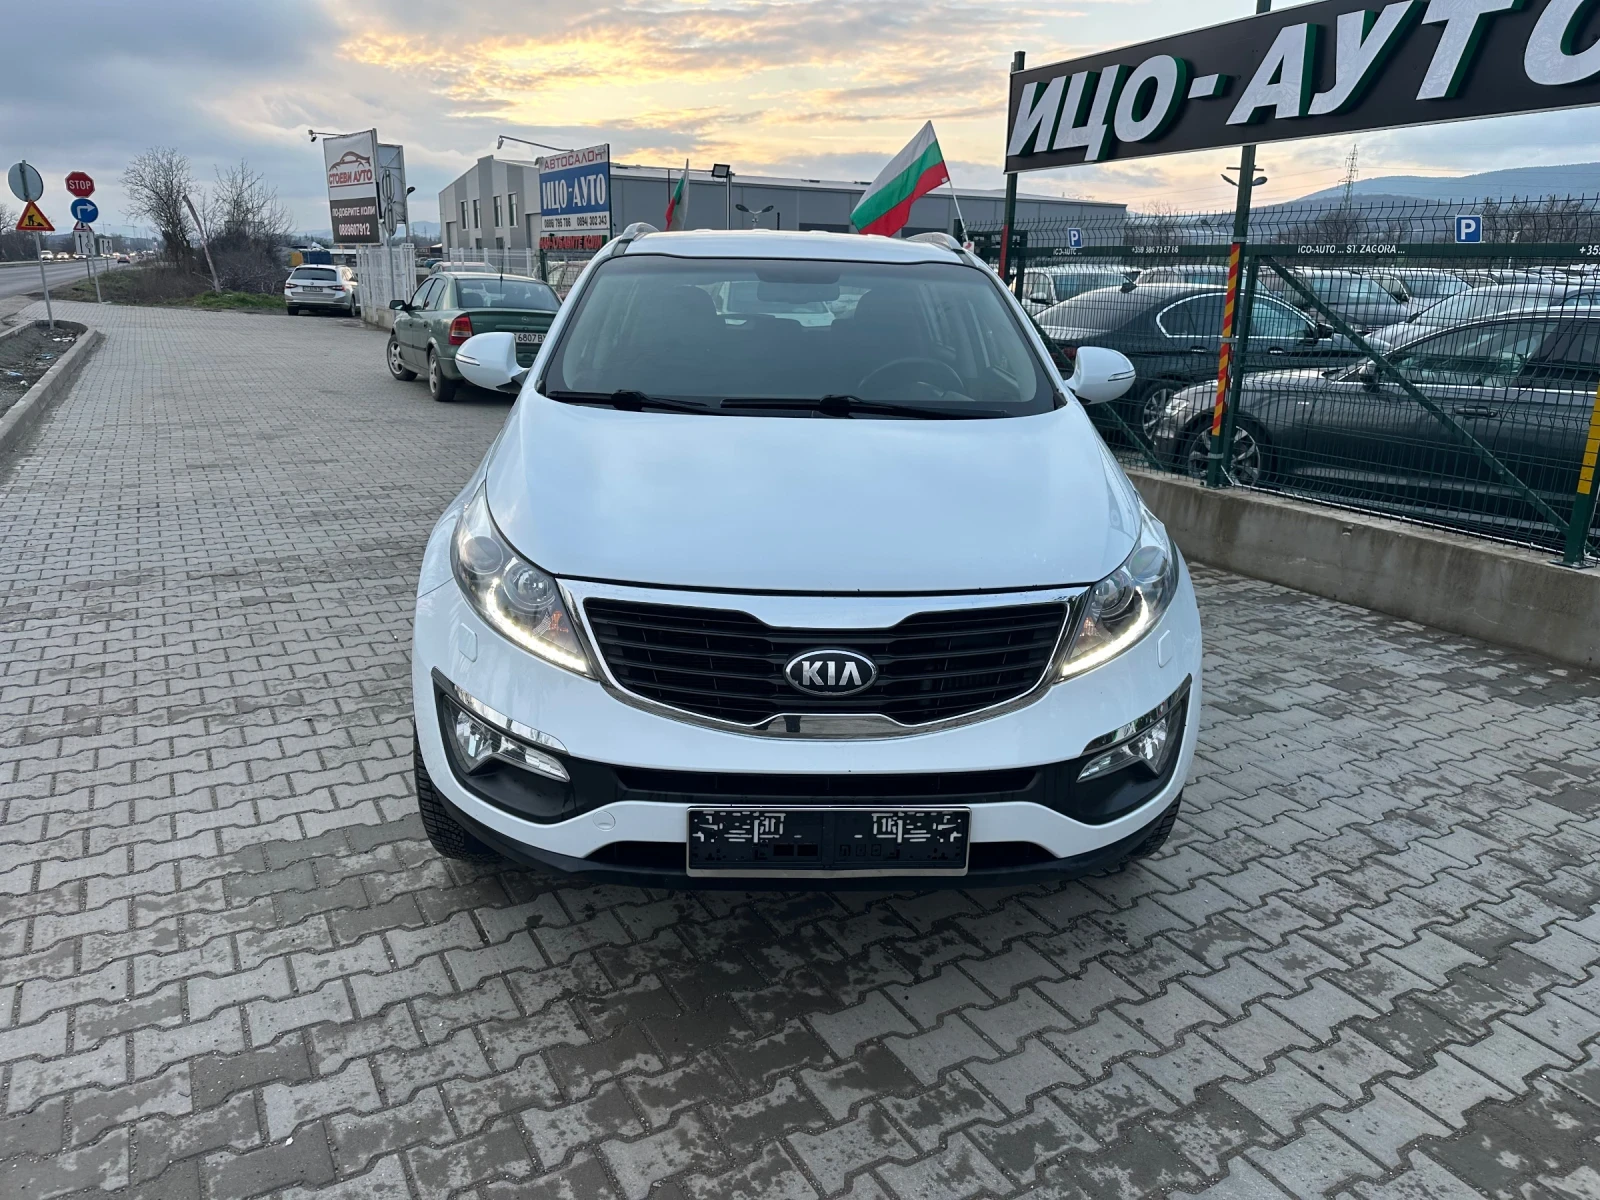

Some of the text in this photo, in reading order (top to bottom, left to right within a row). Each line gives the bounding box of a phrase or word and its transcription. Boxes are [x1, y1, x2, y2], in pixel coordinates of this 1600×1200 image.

[329, 169, 373, 185] СТОЕВИ АУТО
[68, 180, 91, 190] STOP
[360, 205, 376, 215] КОЛИ
[1460, 219, 1476, 240] P
[1070, 230, 1079, 246] P
[1297, 244, 1336, 254] ICO-AUTO
[1359, 244, 1397, 254] ZAGORA
[1579, 245, 1600, 256] +35
[518, 334, 536, 342] 6807
[801, 661, 863, 686] KIA
